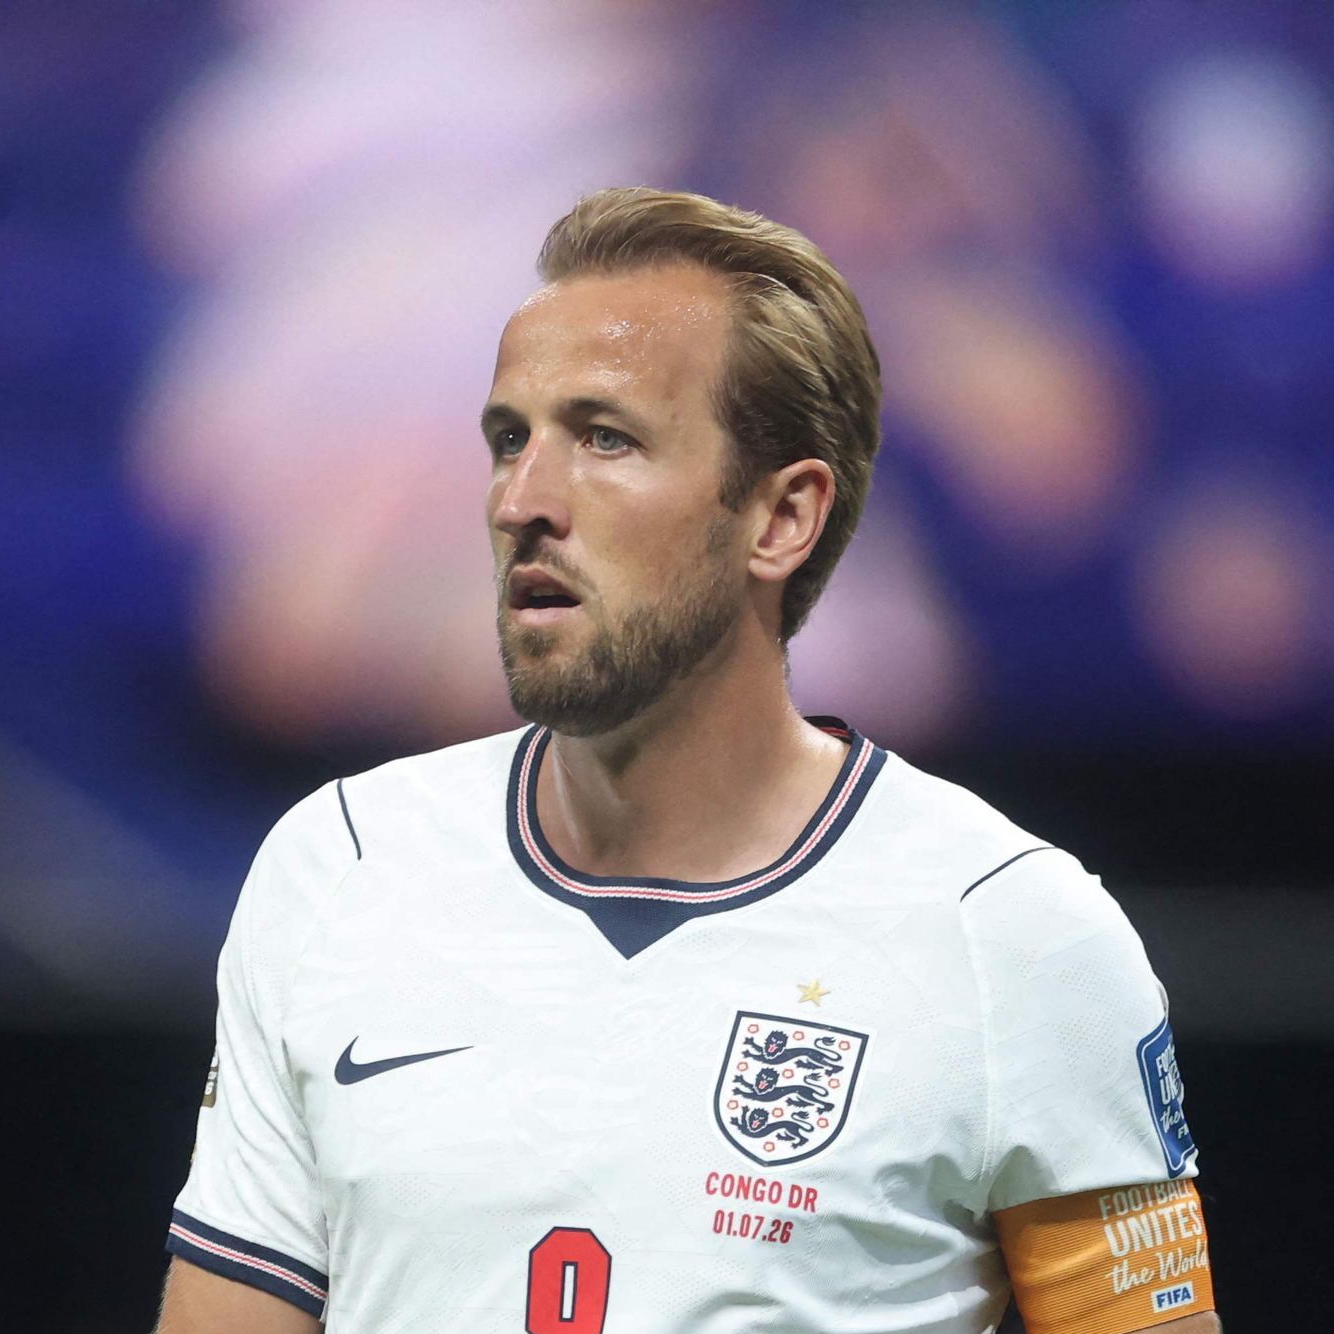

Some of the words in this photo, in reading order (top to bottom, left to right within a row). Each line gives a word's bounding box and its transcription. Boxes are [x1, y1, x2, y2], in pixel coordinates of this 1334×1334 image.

[705, 1171, 783, 1204] CONGO
[788, 1184, 818, 1213] DR
[1099, 1180, 1194, 1220] FOOTBALL
[712, 1209, 794, 1244] 01.07.26
[1104, 1200, 1203, 1257] UNITES
[1104, 1259, 1155, 1294] the
[1155, 1238, 1209, 1280] World
[1156, 1286, 1192, 1308] FIFA
